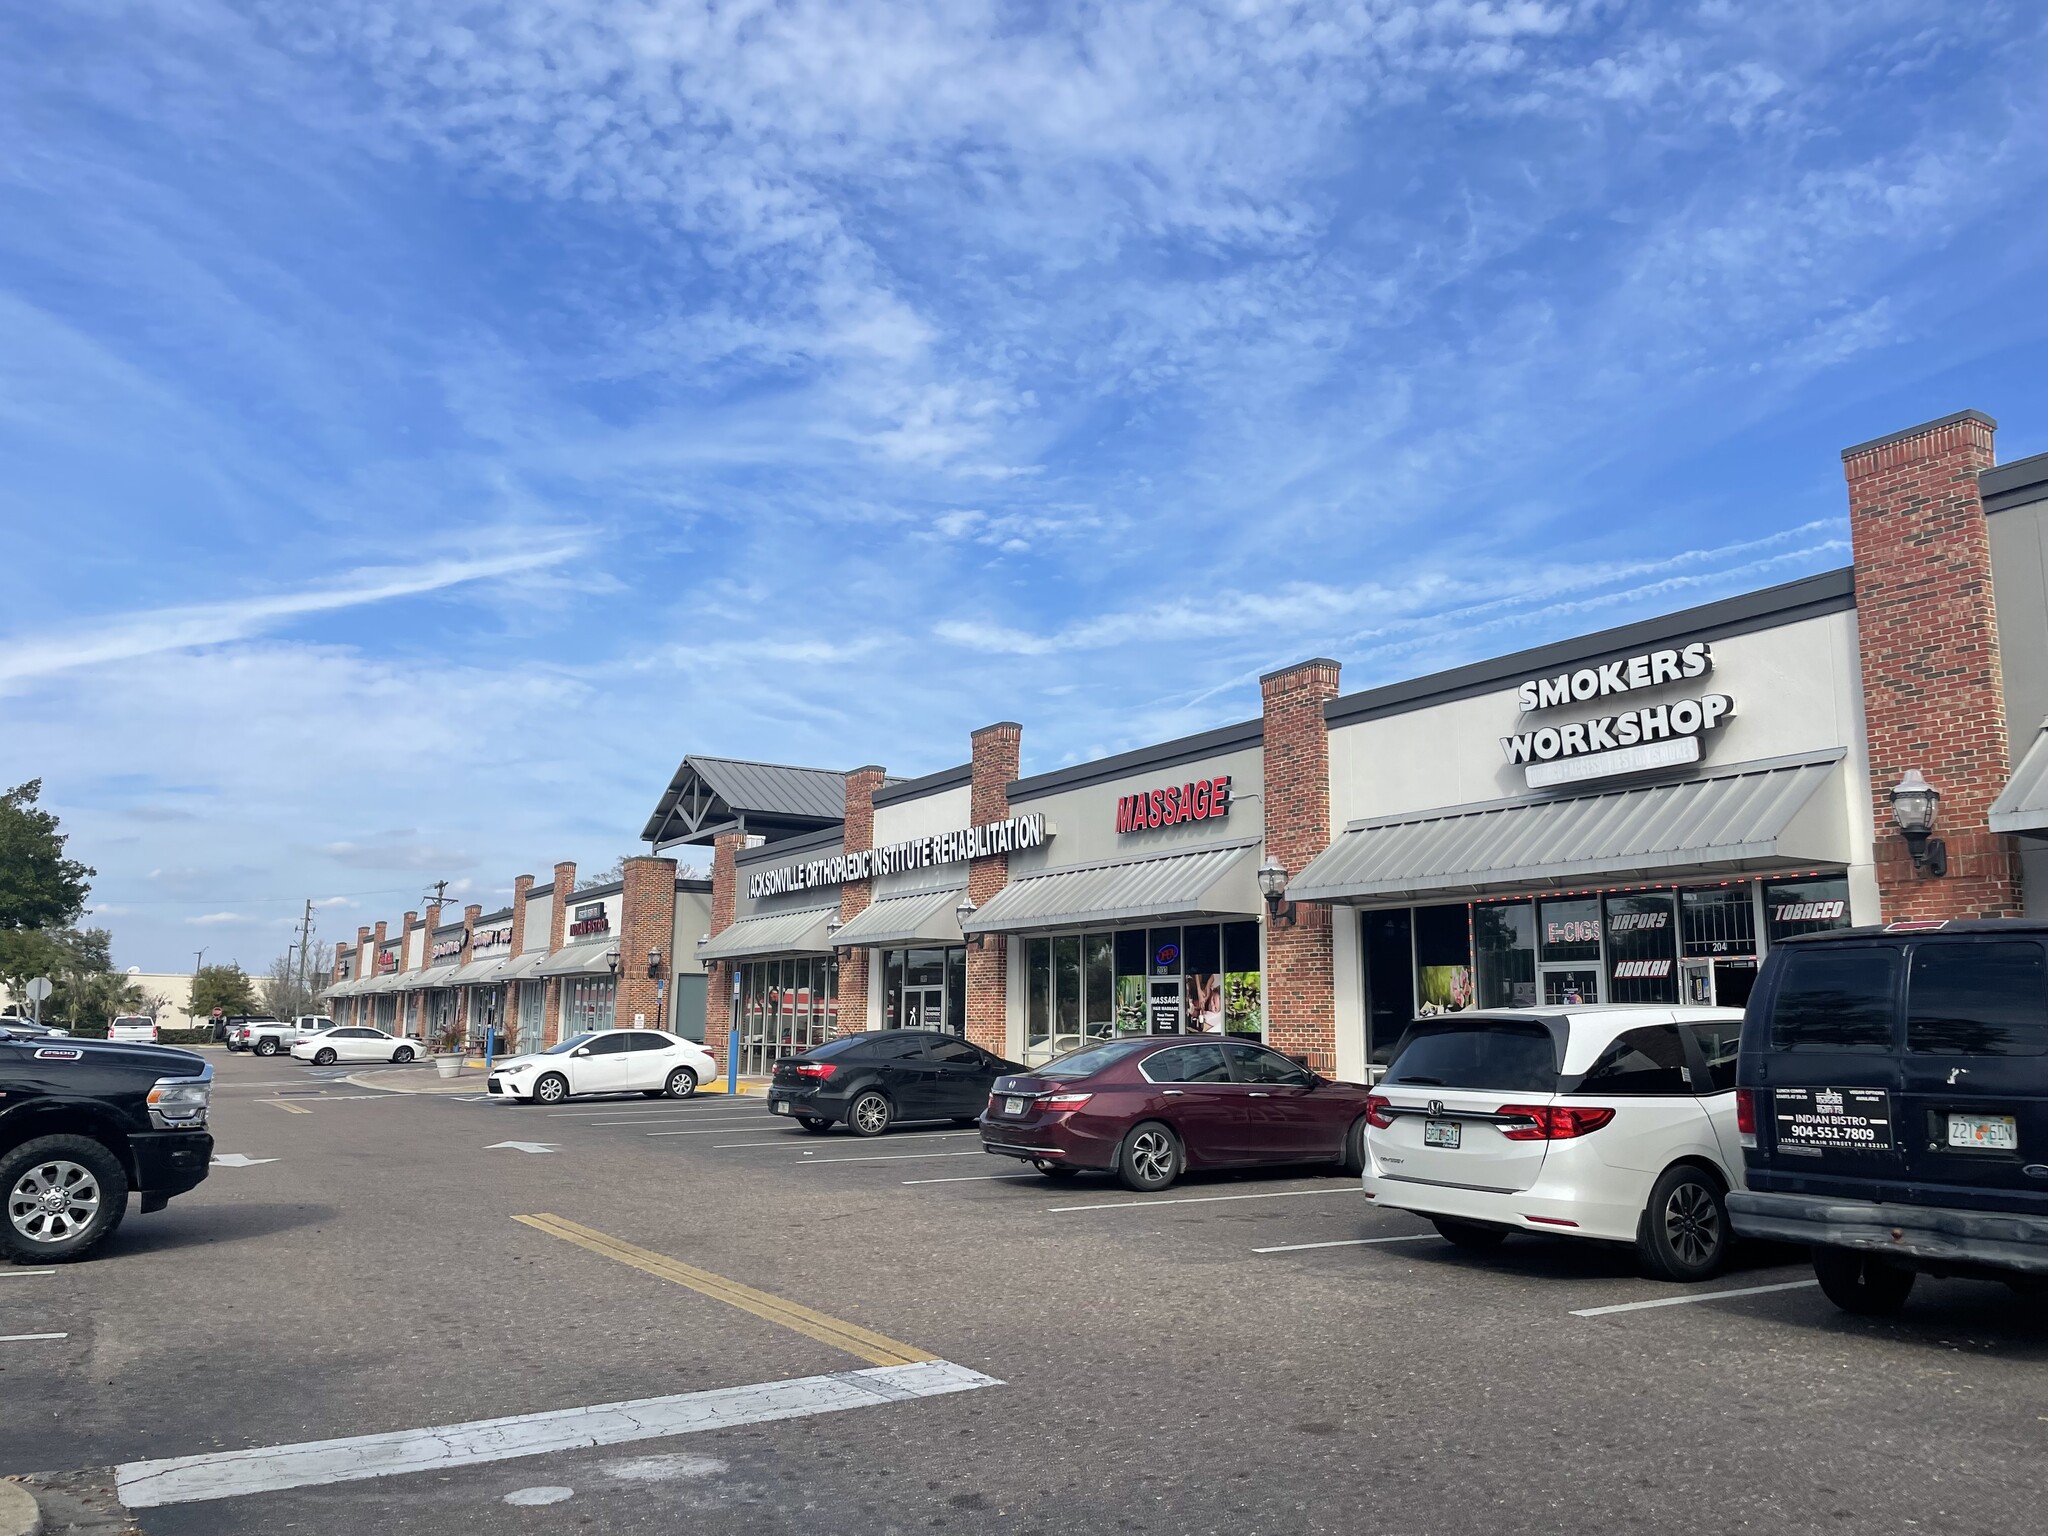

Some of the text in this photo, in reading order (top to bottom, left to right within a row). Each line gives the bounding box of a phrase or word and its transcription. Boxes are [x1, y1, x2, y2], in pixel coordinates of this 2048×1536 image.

[1518, 642, 1709, 712] SMOKERS
[1499, 694, 1729, 765] WORKSHOP
[1116, 775, 1229, 834] MASSAGE
[746, 812, 1043, 899] JACKSONVILLE ORTHOPAEDIC INSTITUTE REHABILITATION
[1775, 901, 1845, 921] TOBACCO
[1611, 912, 1668, 930] VAPORS
[1548, 920, 1600, 943] E-CIGS
[1712, 943, 1727, 952] 204
[1615, 960, 1671, 978] HOOKAH
[1151, 996, 1180, 1005] MASSAGE
[1795, 1114, 1867, 1126] INDIAN BISTRO
[1791, 1125, 1875, 1141] 904-551-7809
